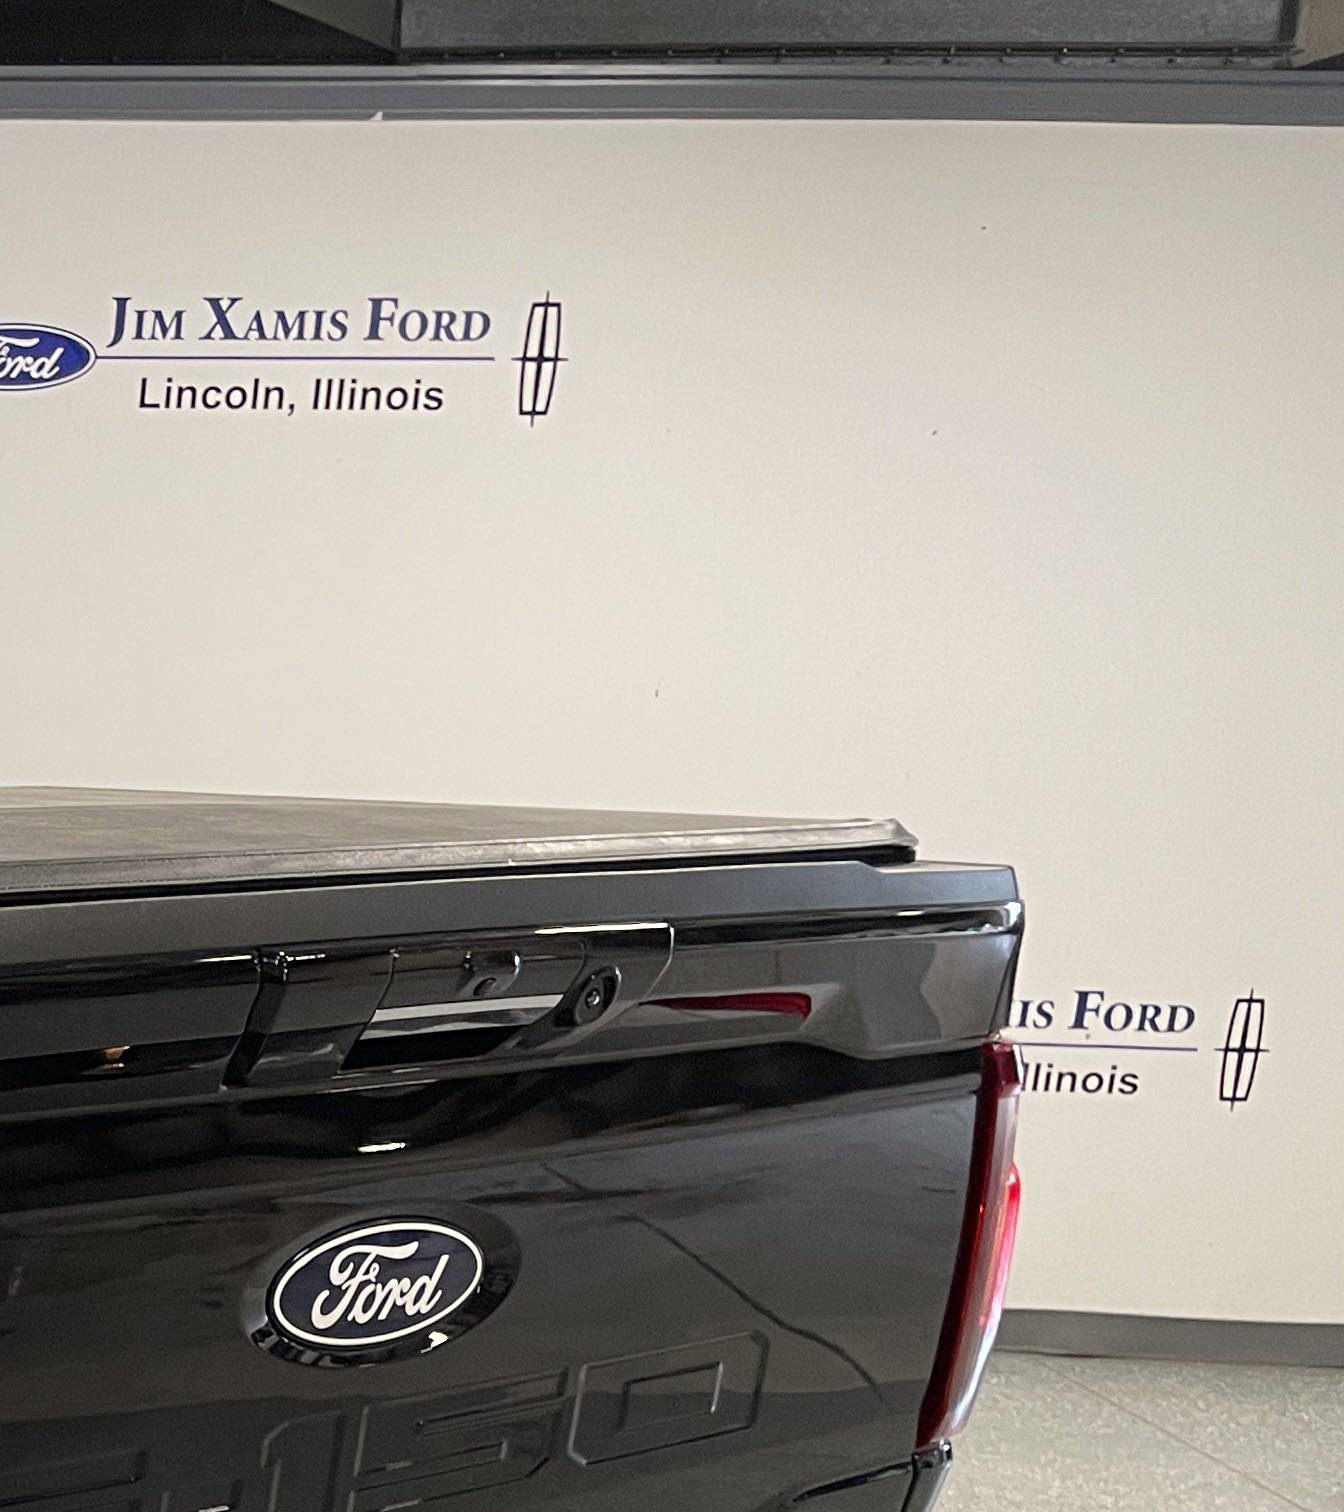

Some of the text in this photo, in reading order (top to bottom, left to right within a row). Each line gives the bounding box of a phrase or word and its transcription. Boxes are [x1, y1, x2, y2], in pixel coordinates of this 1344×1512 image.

[106, 296, 492, 348] JIM XAMIS FORD
[138, 377, 444, 415] Lincoln, Illinois
[1068, 990, 1196, 1034] FORD
[311, 1240, 450, 1330] Ford
